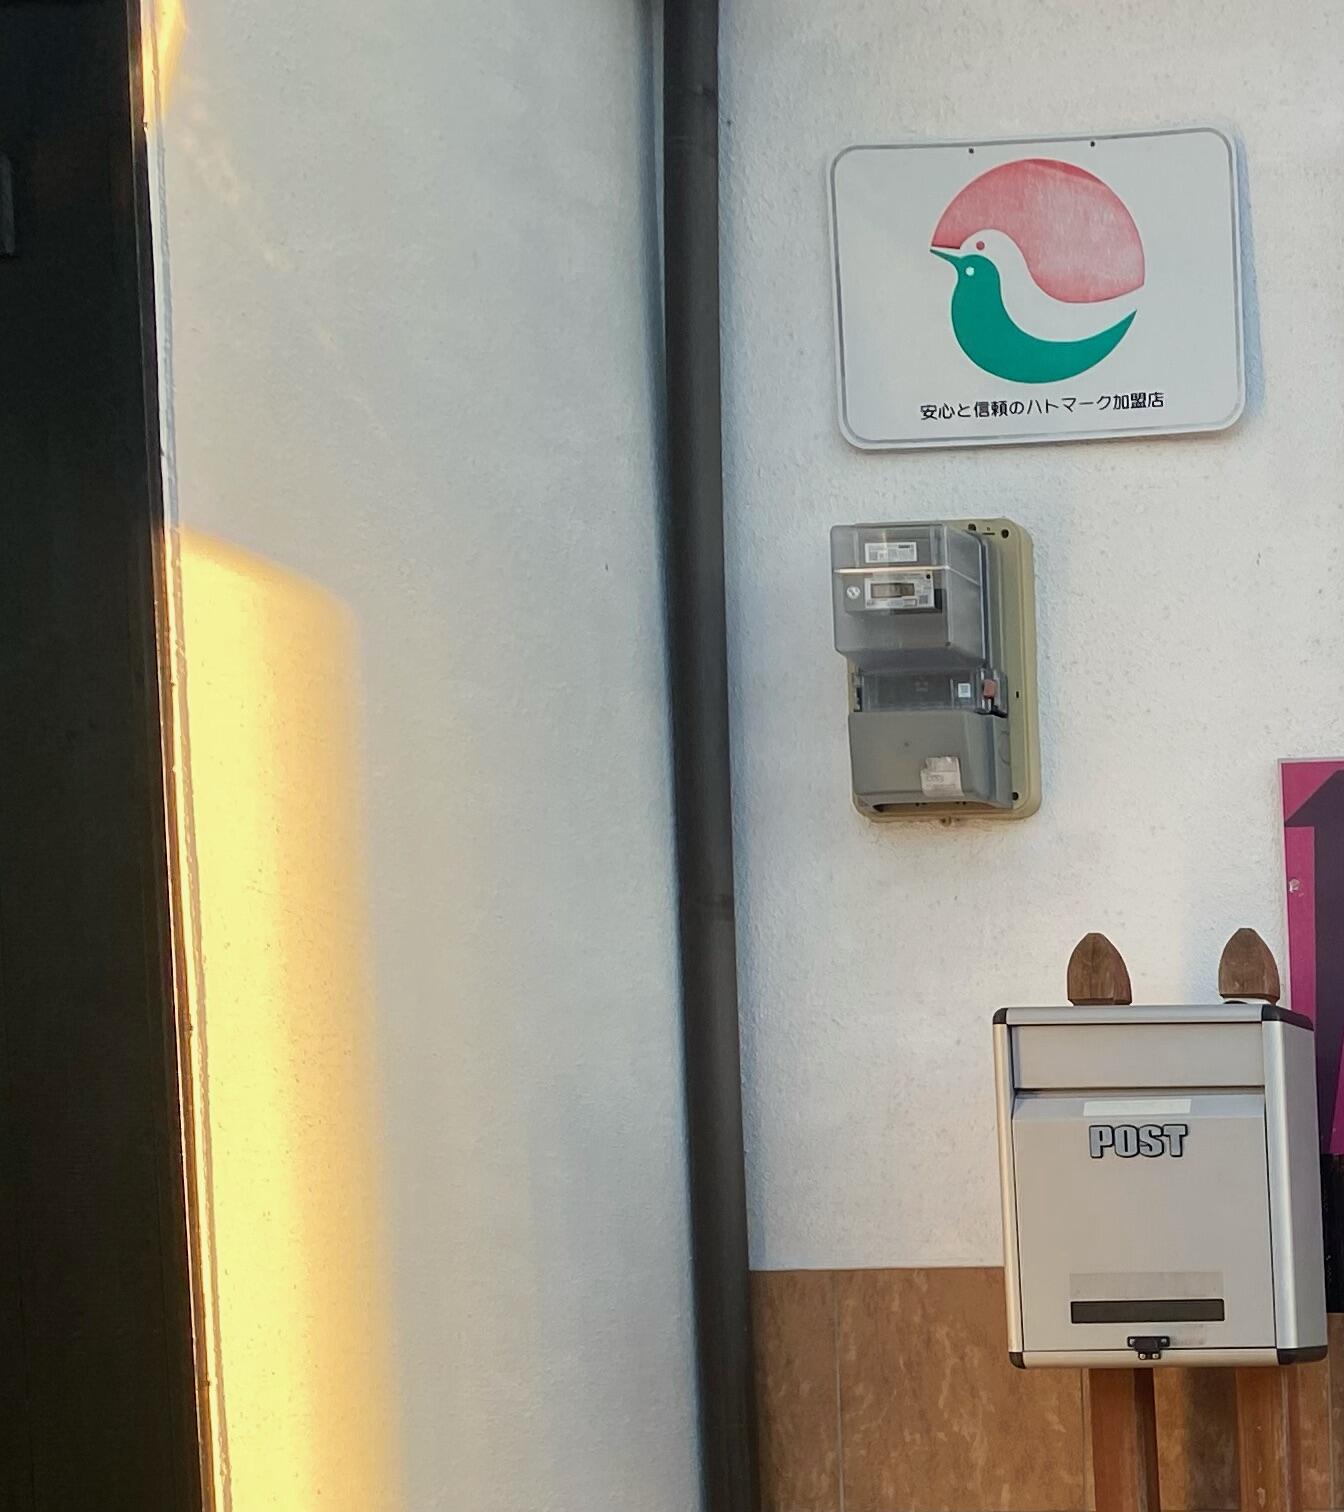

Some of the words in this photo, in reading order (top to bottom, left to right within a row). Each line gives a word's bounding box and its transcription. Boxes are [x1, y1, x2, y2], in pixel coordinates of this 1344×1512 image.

[919, 391, 1165, 421] 安心と信頼のハトマーク加盟店
[1088, 1123, 1189, 1159] POST
